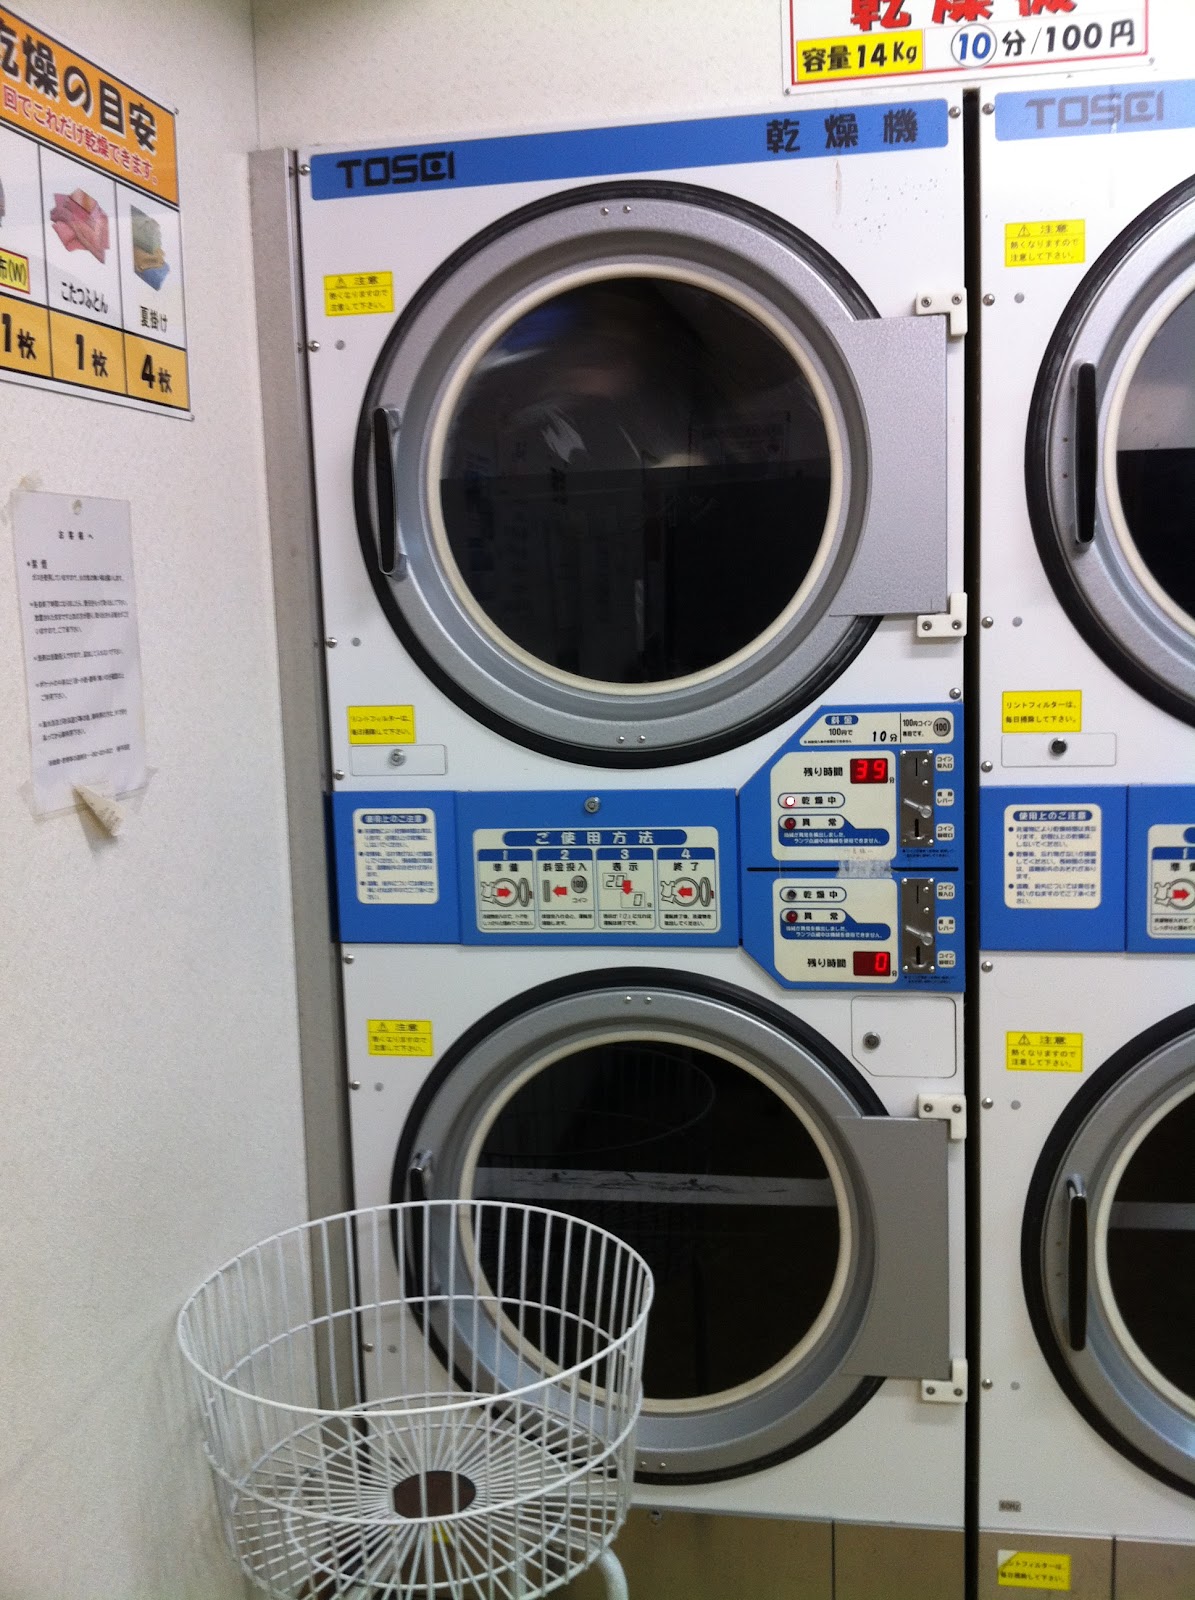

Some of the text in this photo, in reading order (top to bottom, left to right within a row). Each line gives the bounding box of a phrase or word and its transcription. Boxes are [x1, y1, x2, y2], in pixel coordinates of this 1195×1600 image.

[1024, 90, 1165, 130] TOSEI
[766, 109, 918, 154] 乾燥機
[336, 151, 455, 188] TOSEI
[2, 313, 37, 361] 1枚
[75, 333, 109, 378] 1枚
[141, 354, 173, 393] 4枚
[935, 722, 947, 731] 100
[872, 731, 897, 742] 10分
[803, 766, 843, 777] 残り時間
[856, 760, 887, 779] 39
[802, 796, 836, 805] 乾燥中
[1019, 811, 1087, 820] 使用上のご注意
[802, 818, 837, 827] 異常
[535, 831, 654, 845] ご使用方法
[560, 849, 570, 860] 2
[620, 848, 630, 860] 3
[681, 848, 691, 859] 4
[803, 890, 838, 899] 乾燥中
[804, 912, 838, 920] 異常
[807, 958, 847, 968] 残り時間
[875, 952, 888, 973] 0
